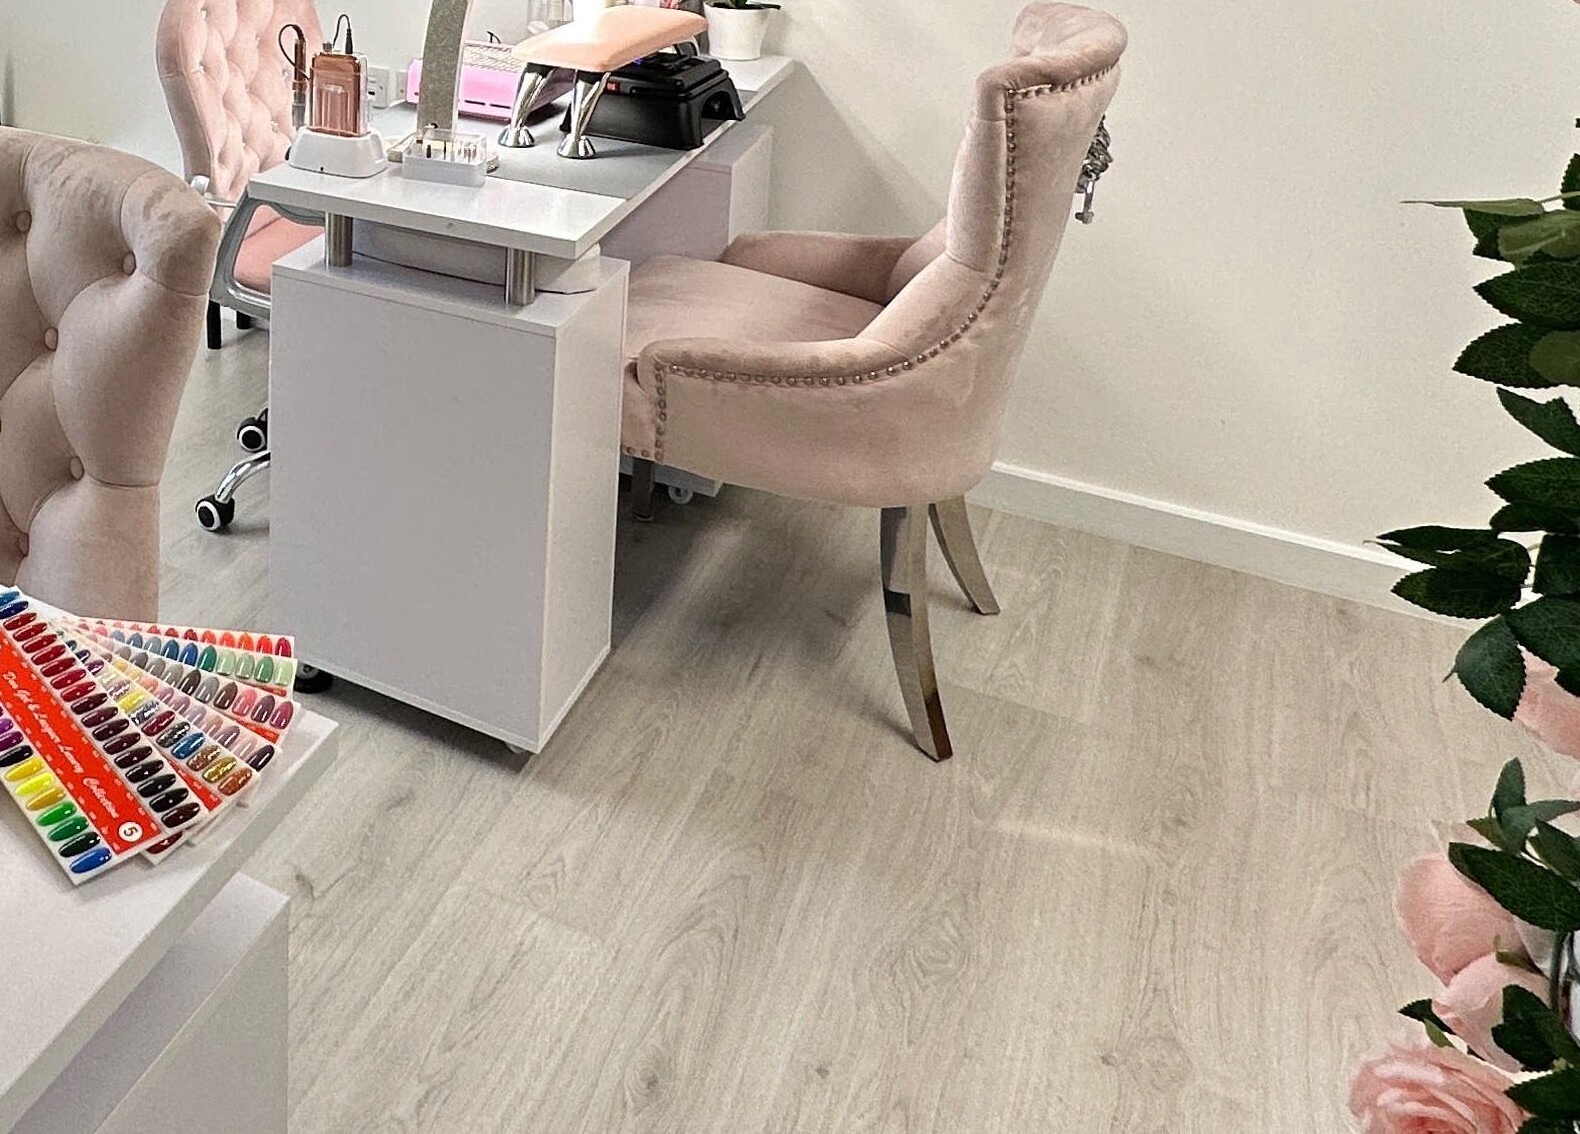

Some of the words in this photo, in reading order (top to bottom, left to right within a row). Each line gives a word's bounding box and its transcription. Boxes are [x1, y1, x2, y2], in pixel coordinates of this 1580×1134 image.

[13, 689, 33, 704] Gel
[58, 743, 84, 773] Luxury
[83, 777, 119, 819] Collection
[124, 826, 138, 837] 5
